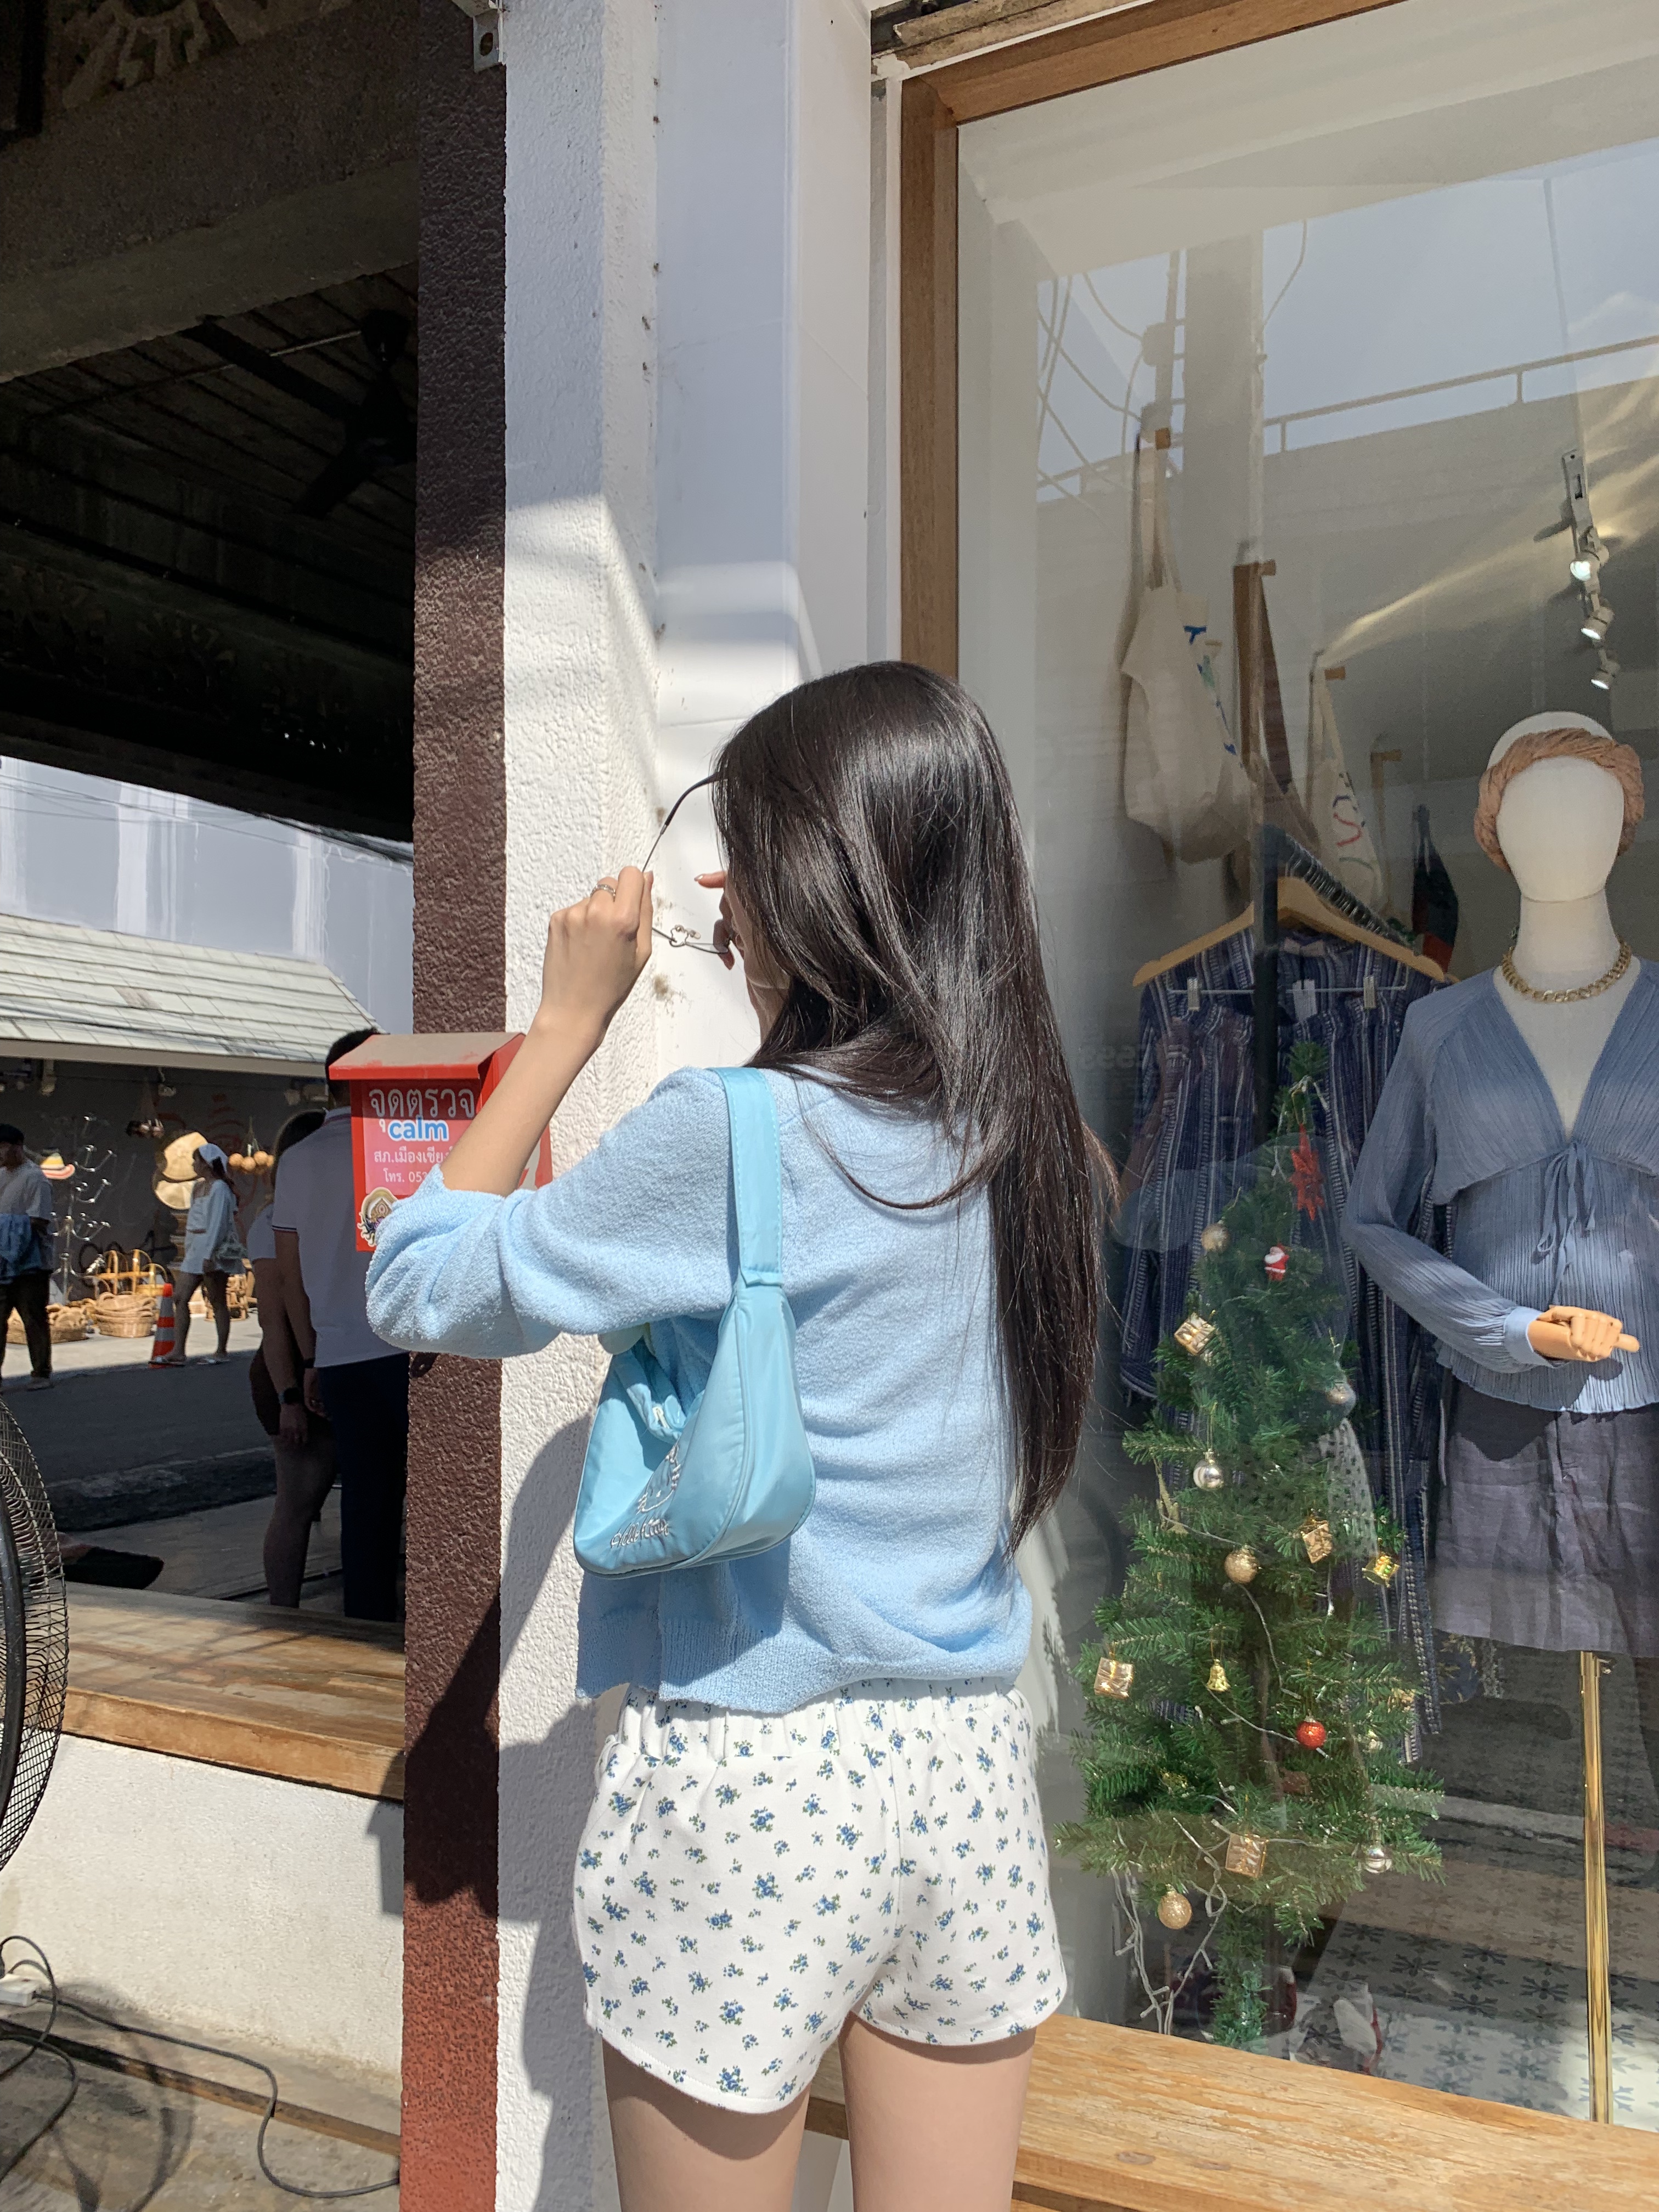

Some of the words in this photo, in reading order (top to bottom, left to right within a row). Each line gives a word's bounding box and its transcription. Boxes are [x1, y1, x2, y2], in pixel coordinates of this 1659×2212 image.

[369, 1088, 476, 1133] จุดตรวจ
[389, 1116, 448, 1139] calm
[374, 1145, 453, 1164] สภ.เมืองเชีย
[383, 1167, 405, 1182] โทร.
